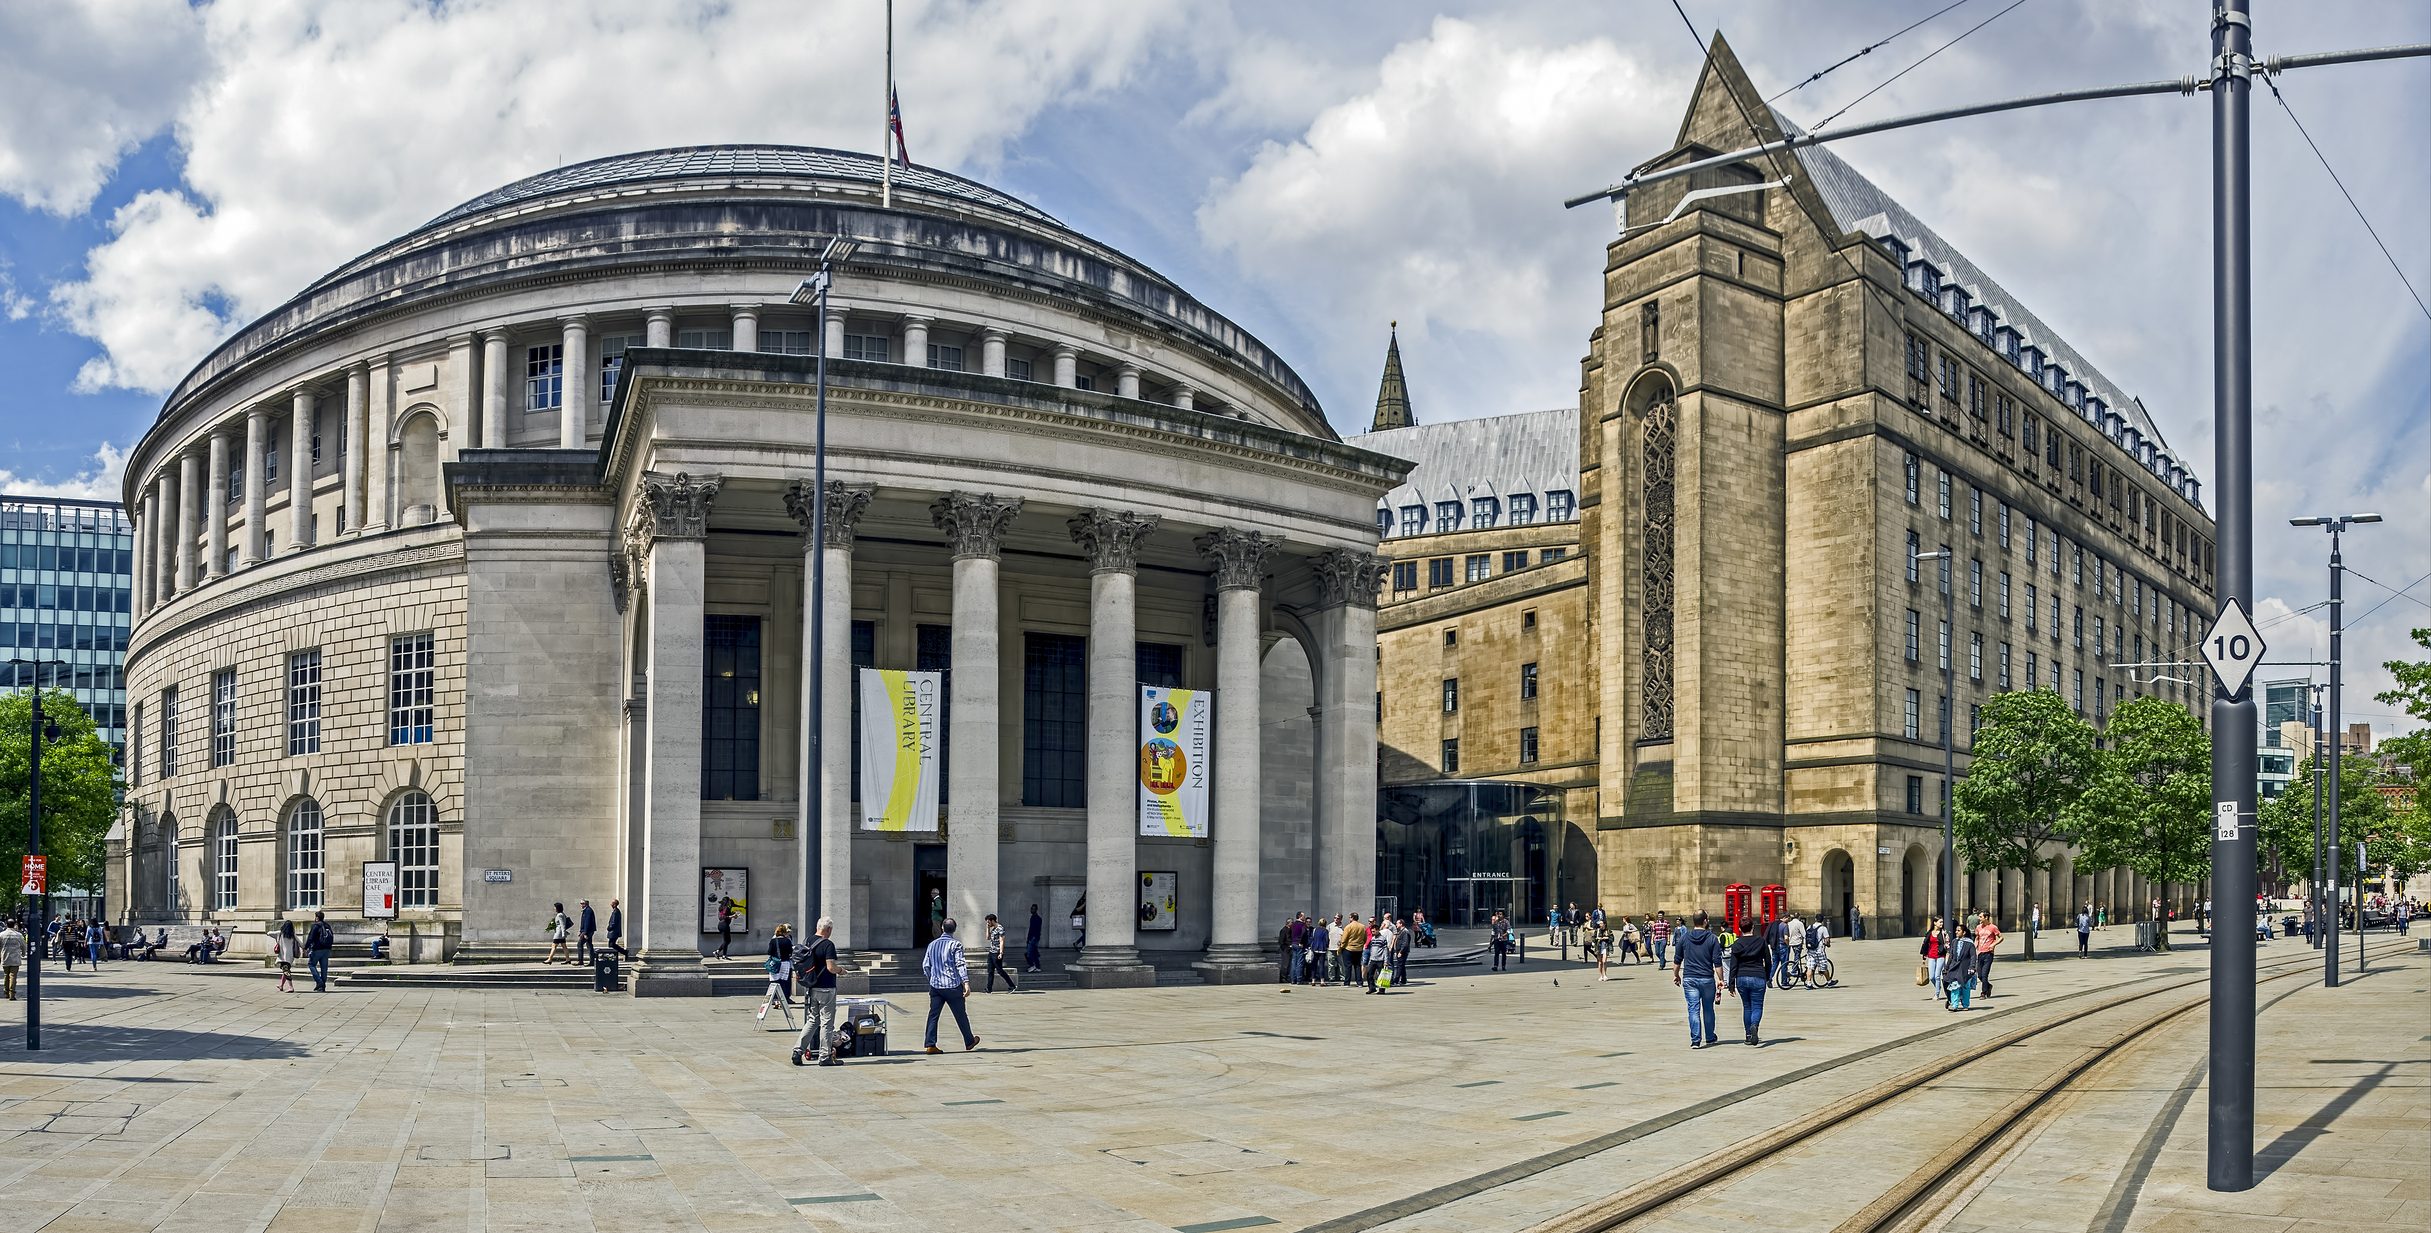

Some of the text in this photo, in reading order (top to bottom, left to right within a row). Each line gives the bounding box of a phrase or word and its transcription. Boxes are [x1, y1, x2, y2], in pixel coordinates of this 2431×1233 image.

[2214, 635, 2250, 660] 10
[902, 680, 916, 752] LIBRARY
[918, 679, 933, 766] CENTRAL
[1192, 700, 1205, 789] EXHIBITION
[2221, 830, 2234, 838] 128
